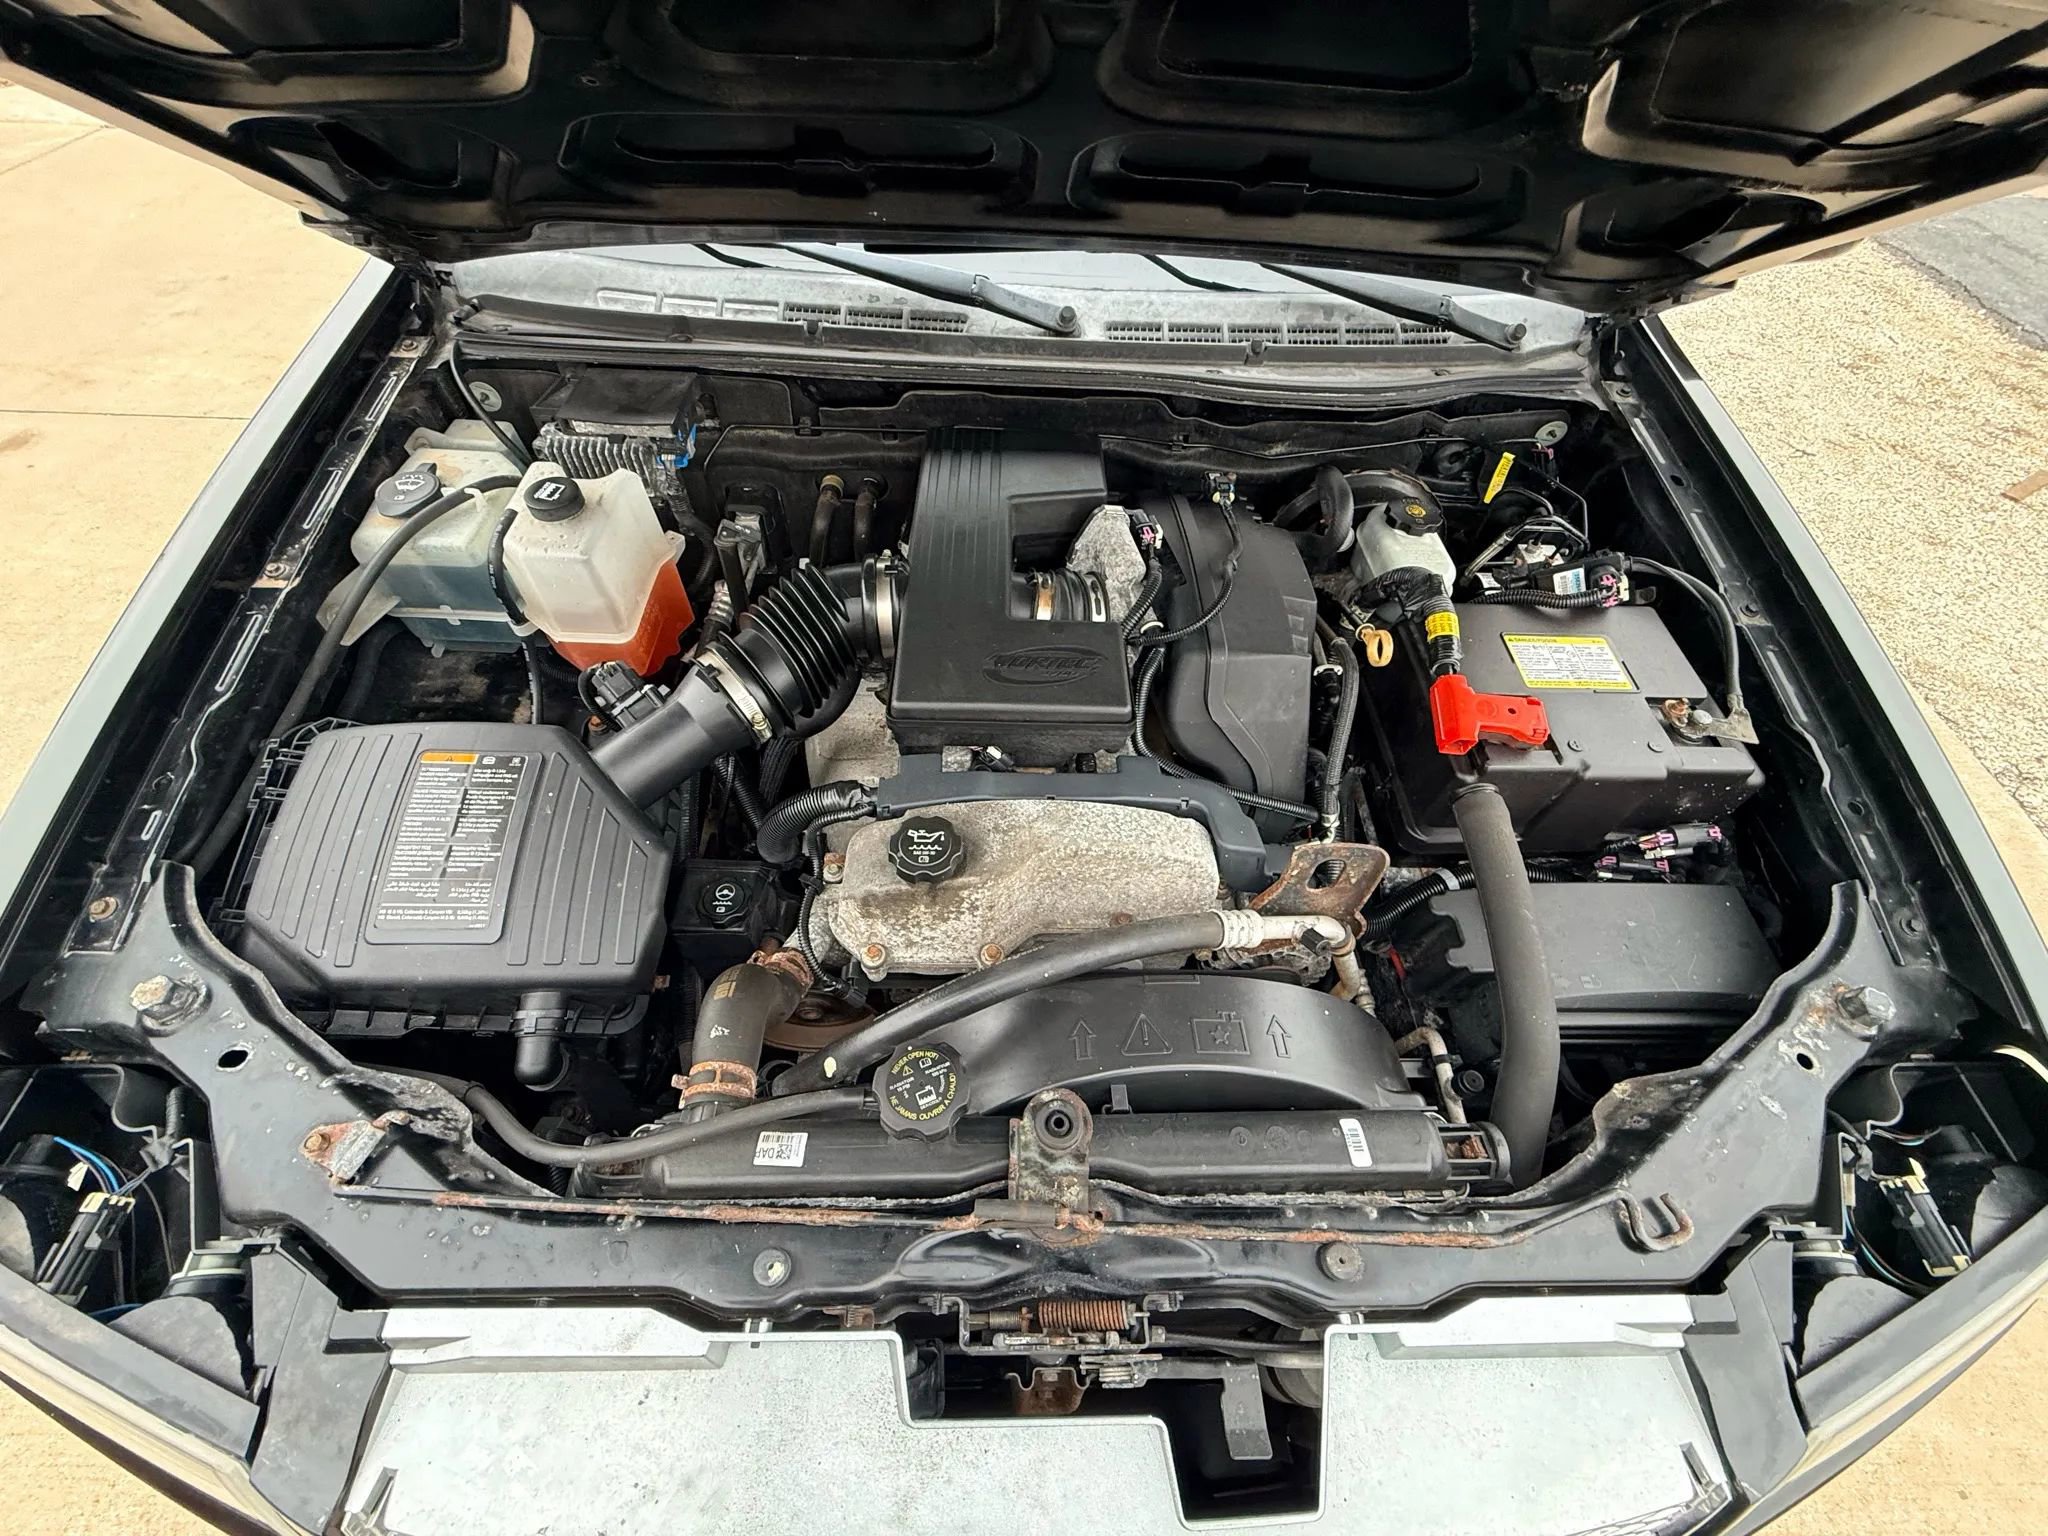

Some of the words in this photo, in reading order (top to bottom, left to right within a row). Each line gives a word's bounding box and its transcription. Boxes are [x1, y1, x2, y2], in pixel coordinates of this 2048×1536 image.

[891, 1056, 909, 1075] NEVER
[907, 1050, 925, 1060] OPEN
[895, 1103, 918, 1121] JAMAIS
[919, 1103, 947, 1121] OUVRIR
